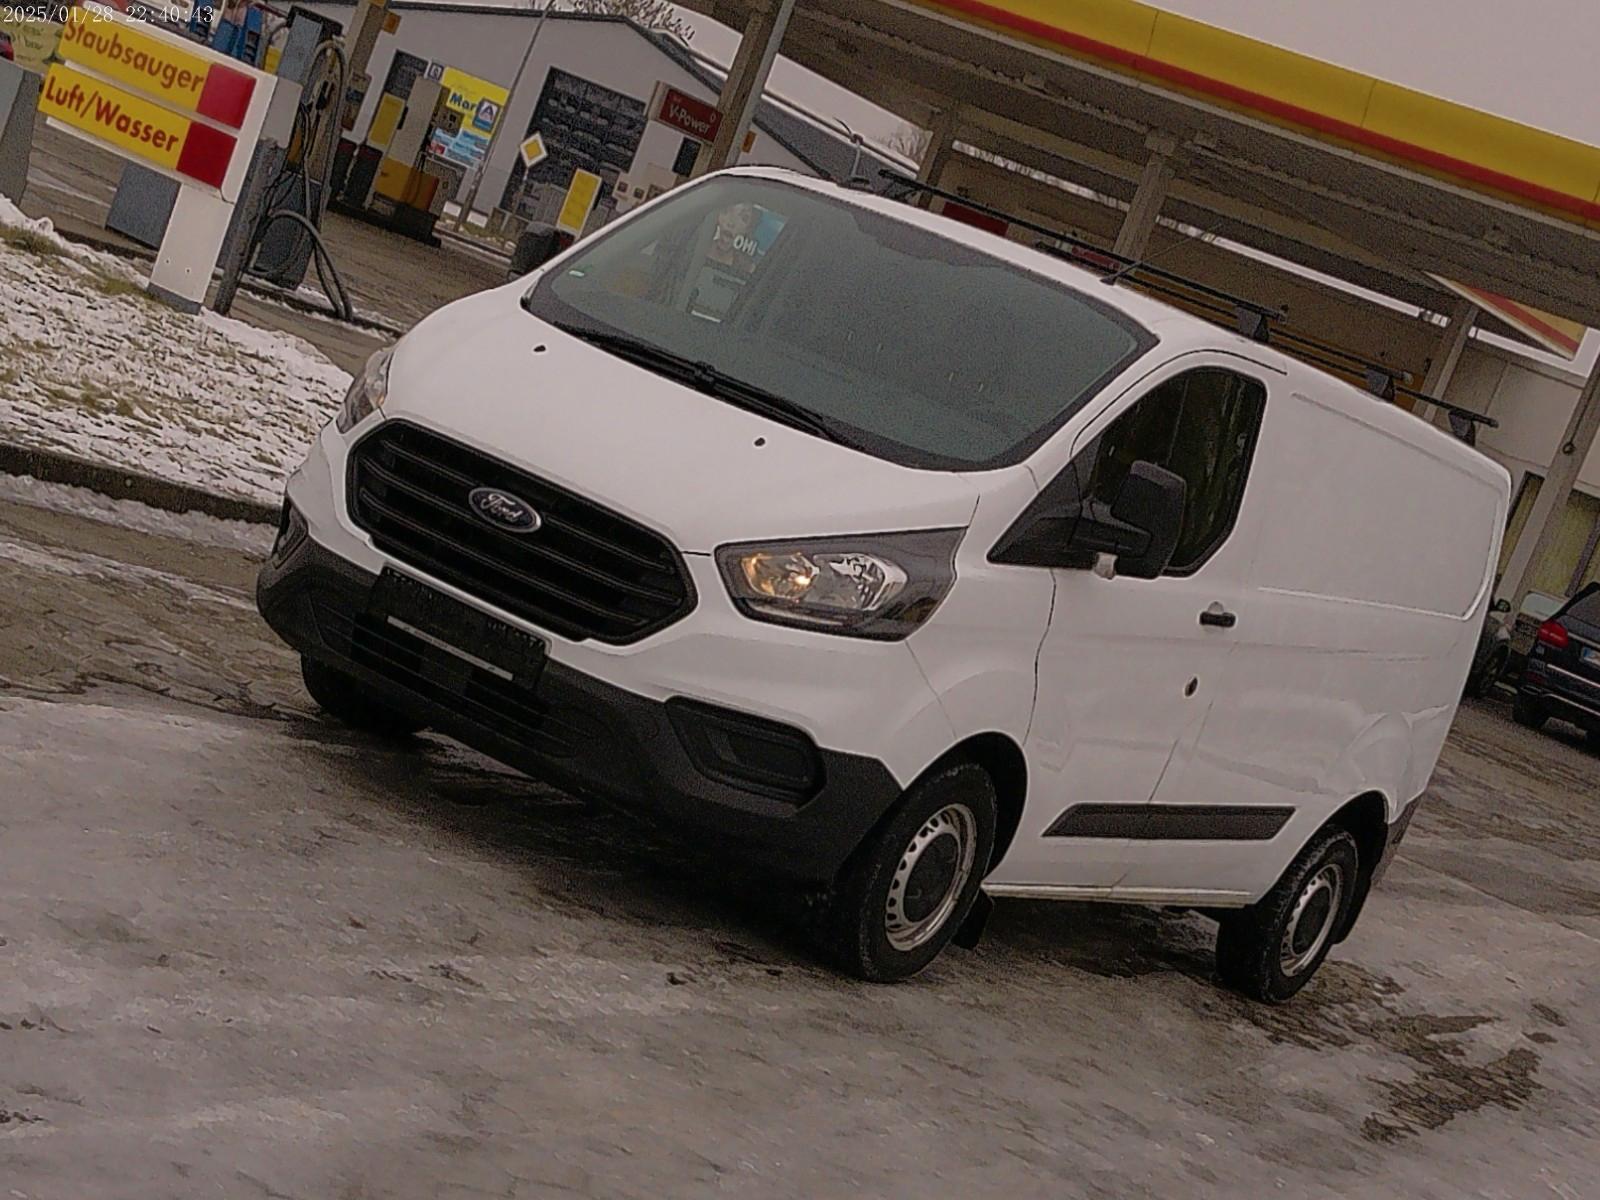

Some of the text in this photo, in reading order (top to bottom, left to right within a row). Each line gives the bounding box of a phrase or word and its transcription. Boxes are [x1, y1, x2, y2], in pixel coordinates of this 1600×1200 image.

[64, 17, 205, 92] Staubsauger
[45, 76, 179, 153] Luft/Wasser
[668, 102, 711, 135] V-Power
[481, 493, 523, 523] Ford
